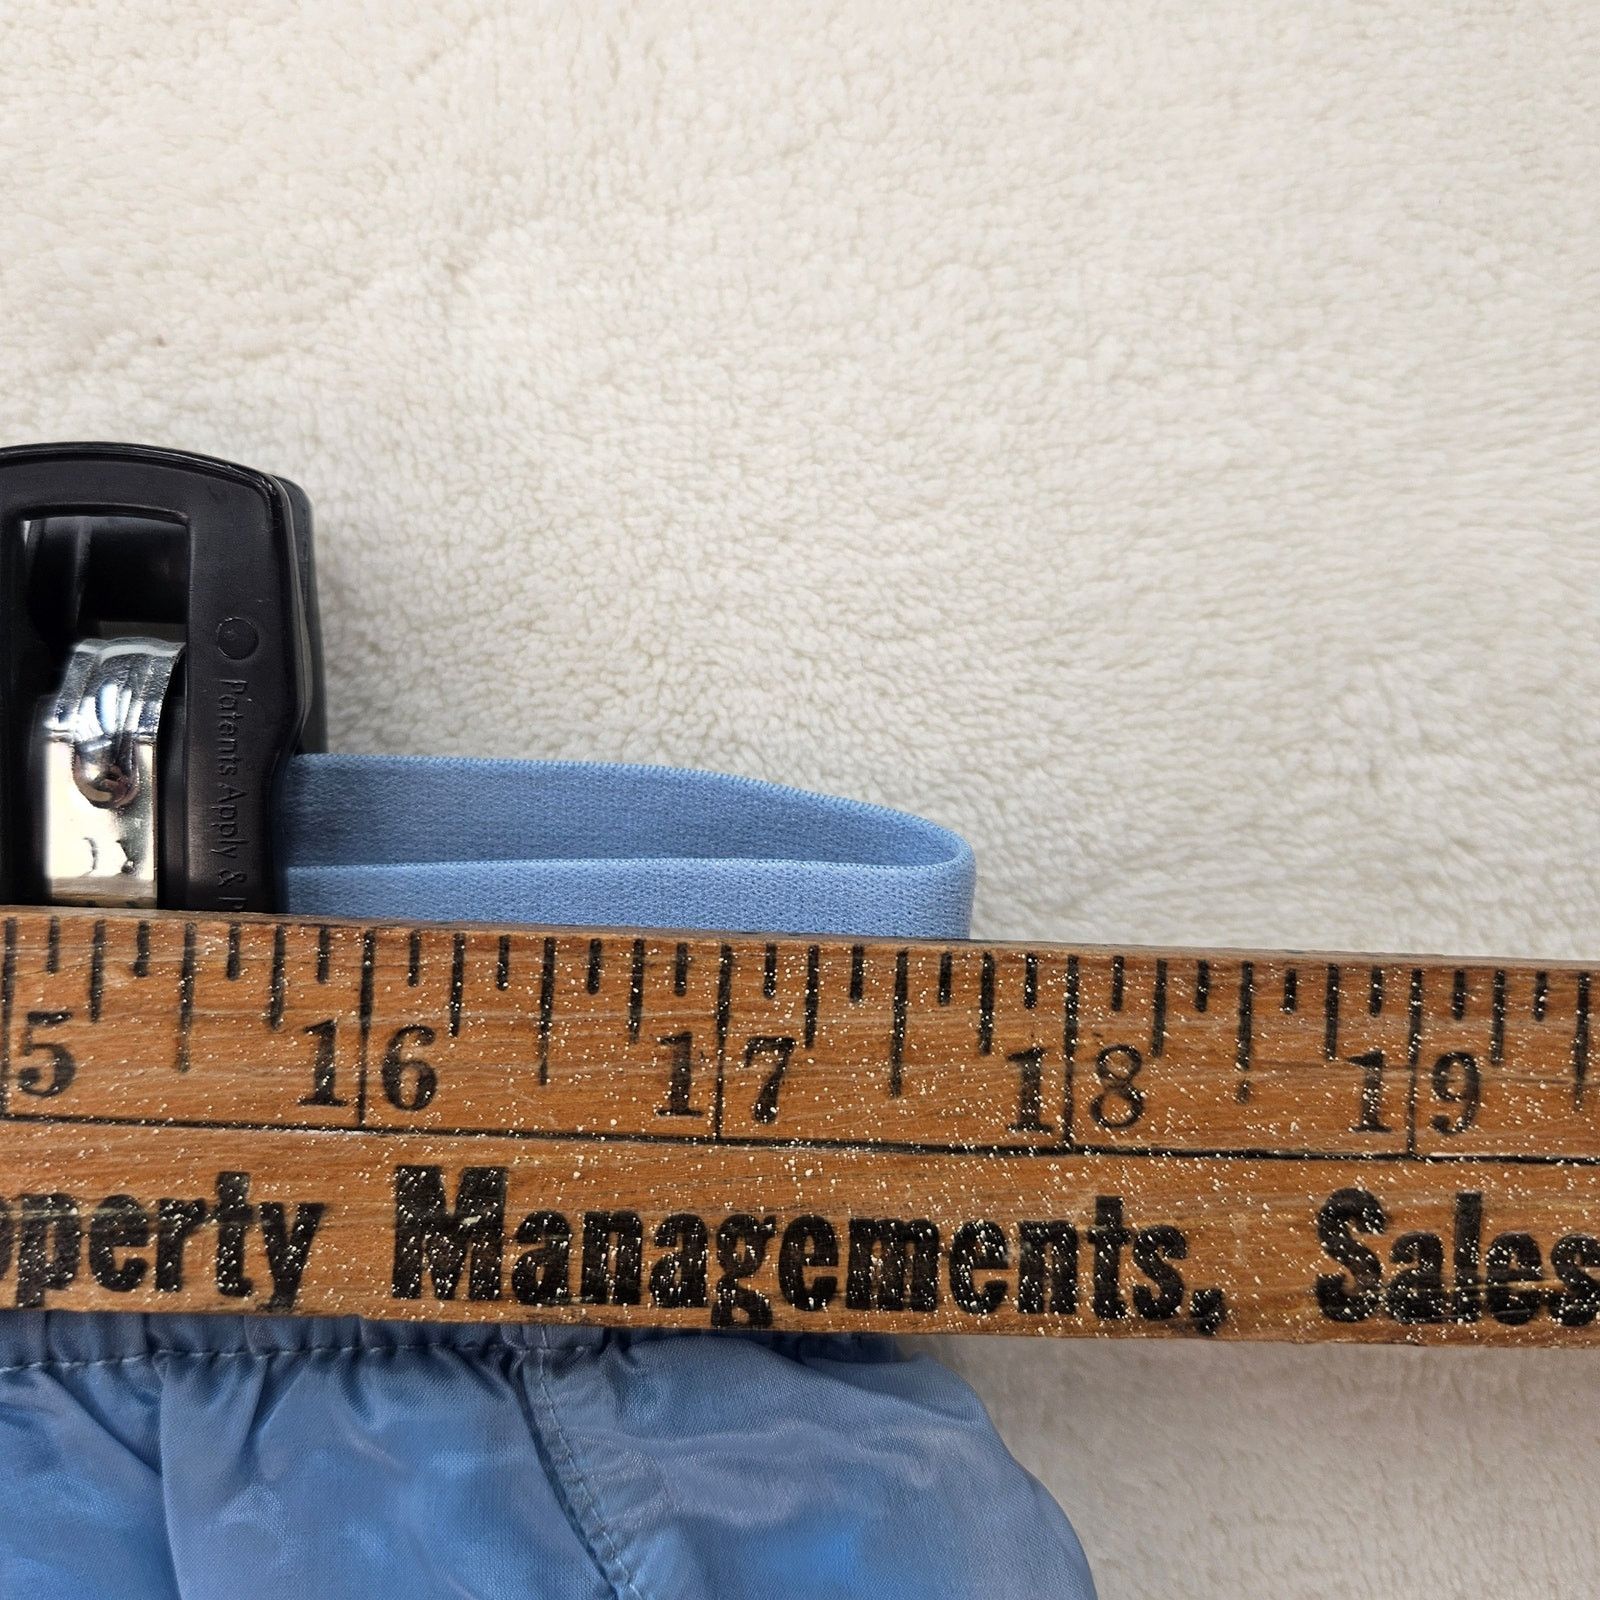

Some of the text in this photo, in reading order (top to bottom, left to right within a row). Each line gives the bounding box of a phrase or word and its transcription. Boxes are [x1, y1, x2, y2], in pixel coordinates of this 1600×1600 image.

[217, 678, 248, 776] Patents
[211, 783, 248, 859] Apply
[217, 868, 248, 888] &
[0, 1165, 1600, 1334] perty Managements, Sales
